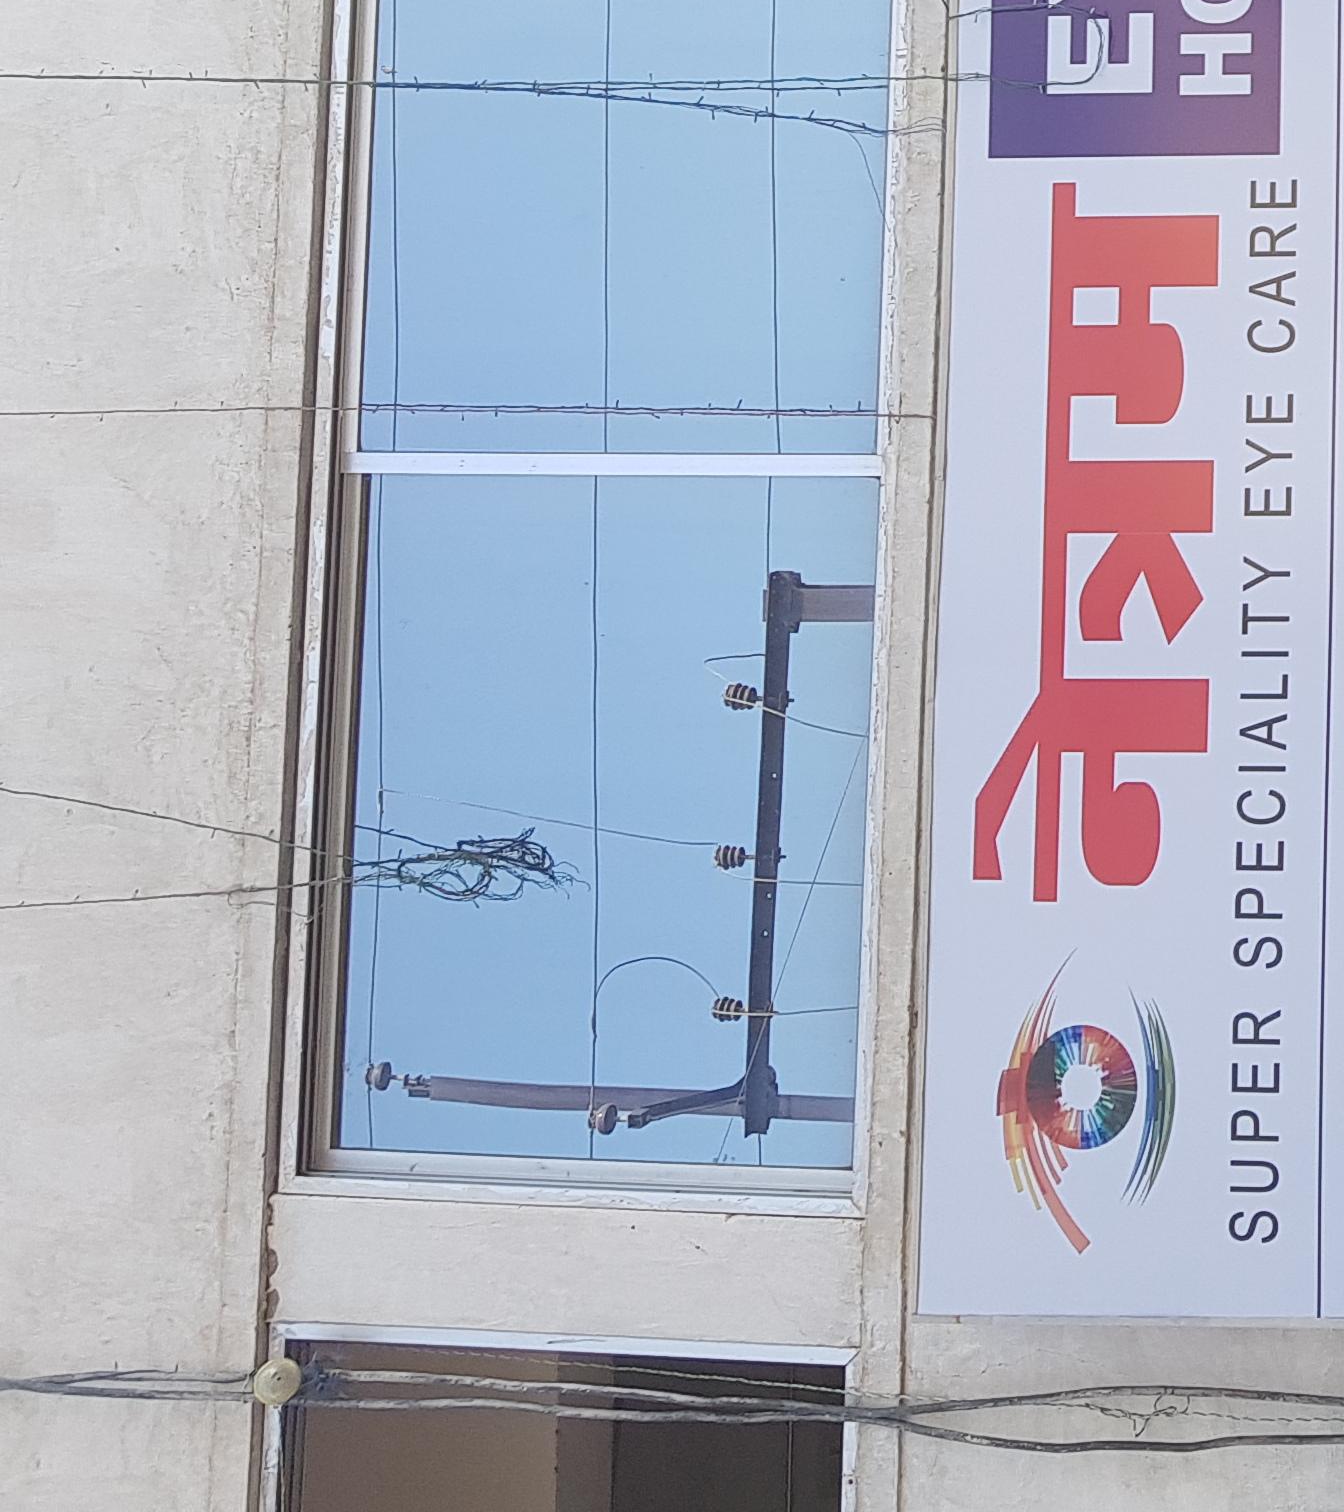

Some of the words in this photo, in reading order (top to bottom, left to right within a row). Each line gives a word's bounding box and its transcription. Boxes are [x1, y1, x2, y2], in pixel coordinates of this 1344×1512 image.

[1246, 177, 1299, 354] CARE
[972, 181, 1220, 902] नेत्रम
[1243, 393, 1294, 517] EYE
[1232, 555, 1292, 969] SPECIALITY
[1228, 1009, 1282, 1244] SUPER
